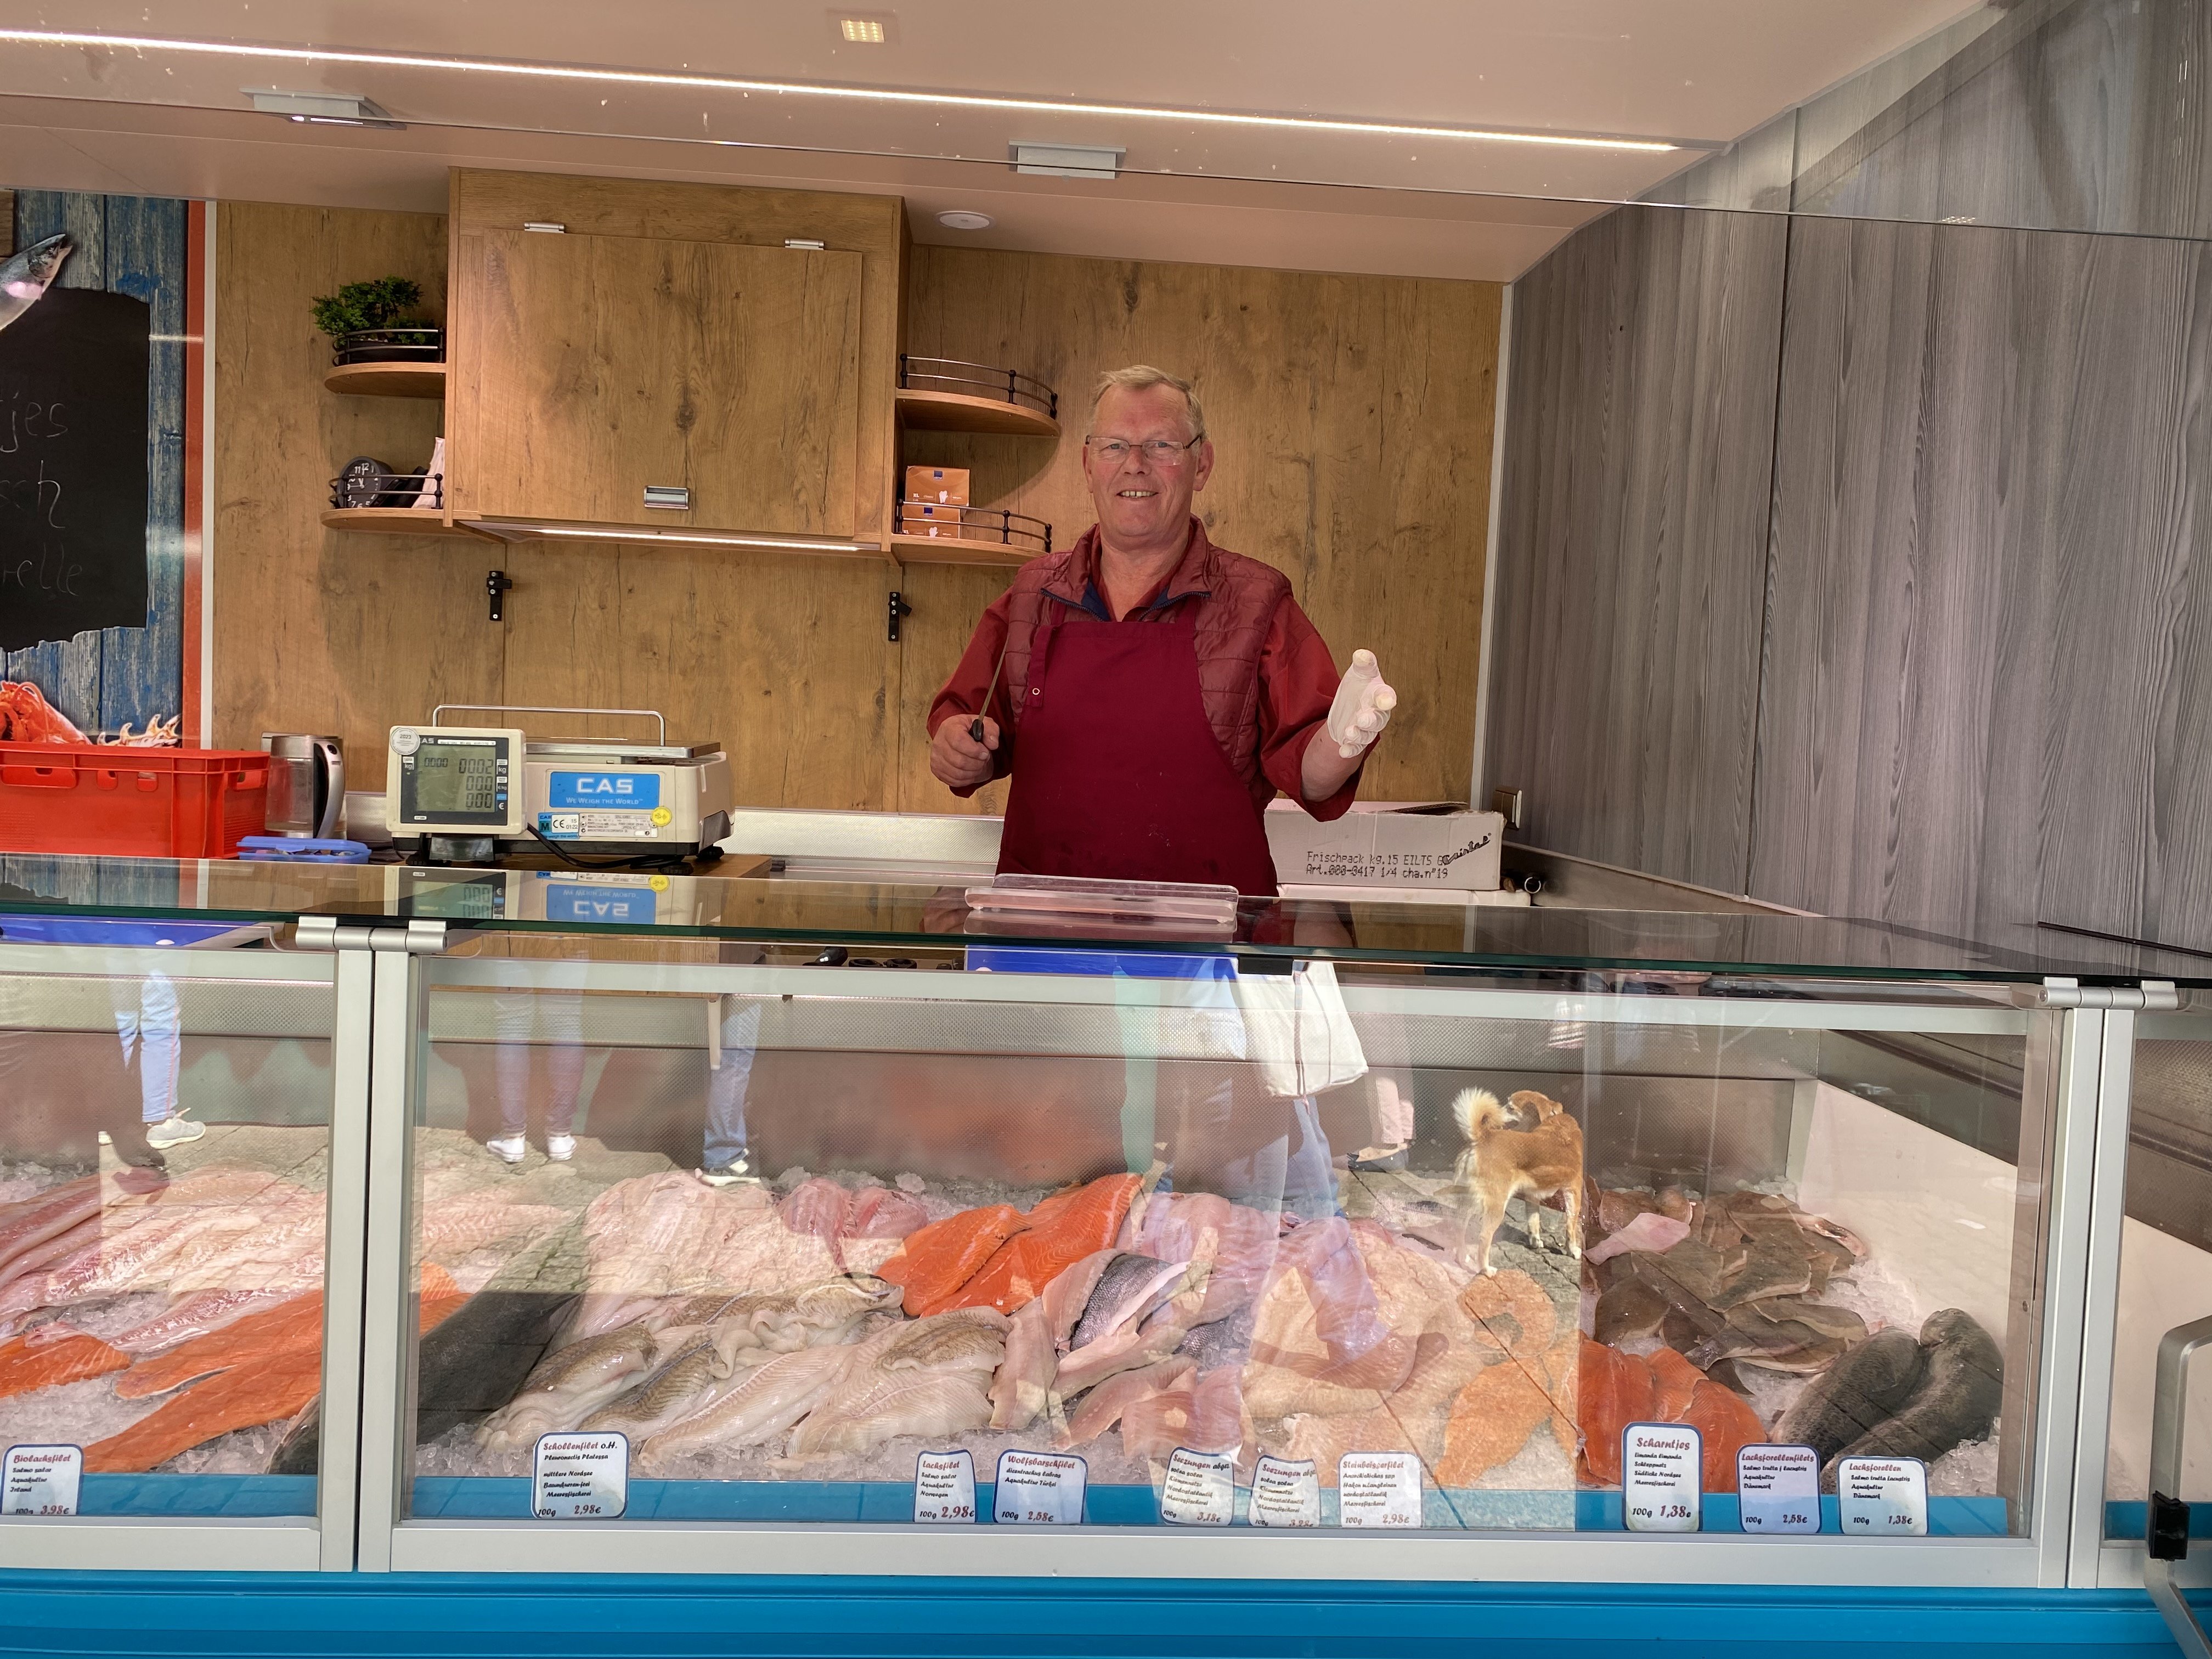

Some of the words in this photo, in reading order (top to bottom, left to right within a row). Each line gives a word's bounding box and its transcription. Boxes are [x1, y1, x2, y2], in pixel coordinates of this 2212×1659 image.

[0, 391, 67, 453] jes
[577, 777, 634, 794] CAS
[1307, 851, 1364, 865] Frischpack
[1369, 854, 1398, 866] kg.15
[544, 1442, 599, 1452] Schollenfilet
[600, 1441, 618, 1449] o.H.
[1637, 1437, 1690, 1451] Scharntjes
[14, 1454, 71, 1464] Biolachsfilet
[1008, 1455, 1075, 1469] Wolfsbarschfilet
[1173, 1454, 1211, 1469] Seezungen
[1741, 1453, 1815, 1463] Lachsforellenfilets
[922, 1460, 960, 1471] Lachsfilet
[1170, 1467, 1185, 1475] solea
[1262, 1464, 1301, 1479] Seezungen
[1342, 1461, 1404, 1470] Steinbeisserfilet
[1849, 1463, 1901, 1472] Lachsforellen
[1005, 1477, 1039, 1486] Aquakultur
[538, 1508, 556, 1517] 100g
[574, 1504, 601, 1515] 2,98€
[919, 1511, 937, 1520] 100g
[941, 1505, 975, 1519] 2,98€
[1001, 1511, 1019, 1521] 100g
[1163, 1510, 1177, 1519] 100g
[1197, 1511, 1221, 1522] 3,18€
[1632, 1508, 1652, 1518] 100g
[1660, 1505, 1691, 1518] 1,38€
[1345, 1517, 1363, 1525] 100g
[1382, 1513, 1410, 1525] 2,98€
[1745, 1516, 1762, 1525] 100g
[1853, 1517, 1870, 1525] 100g
[1888, 1515, 1913, 1525] 1,38€
